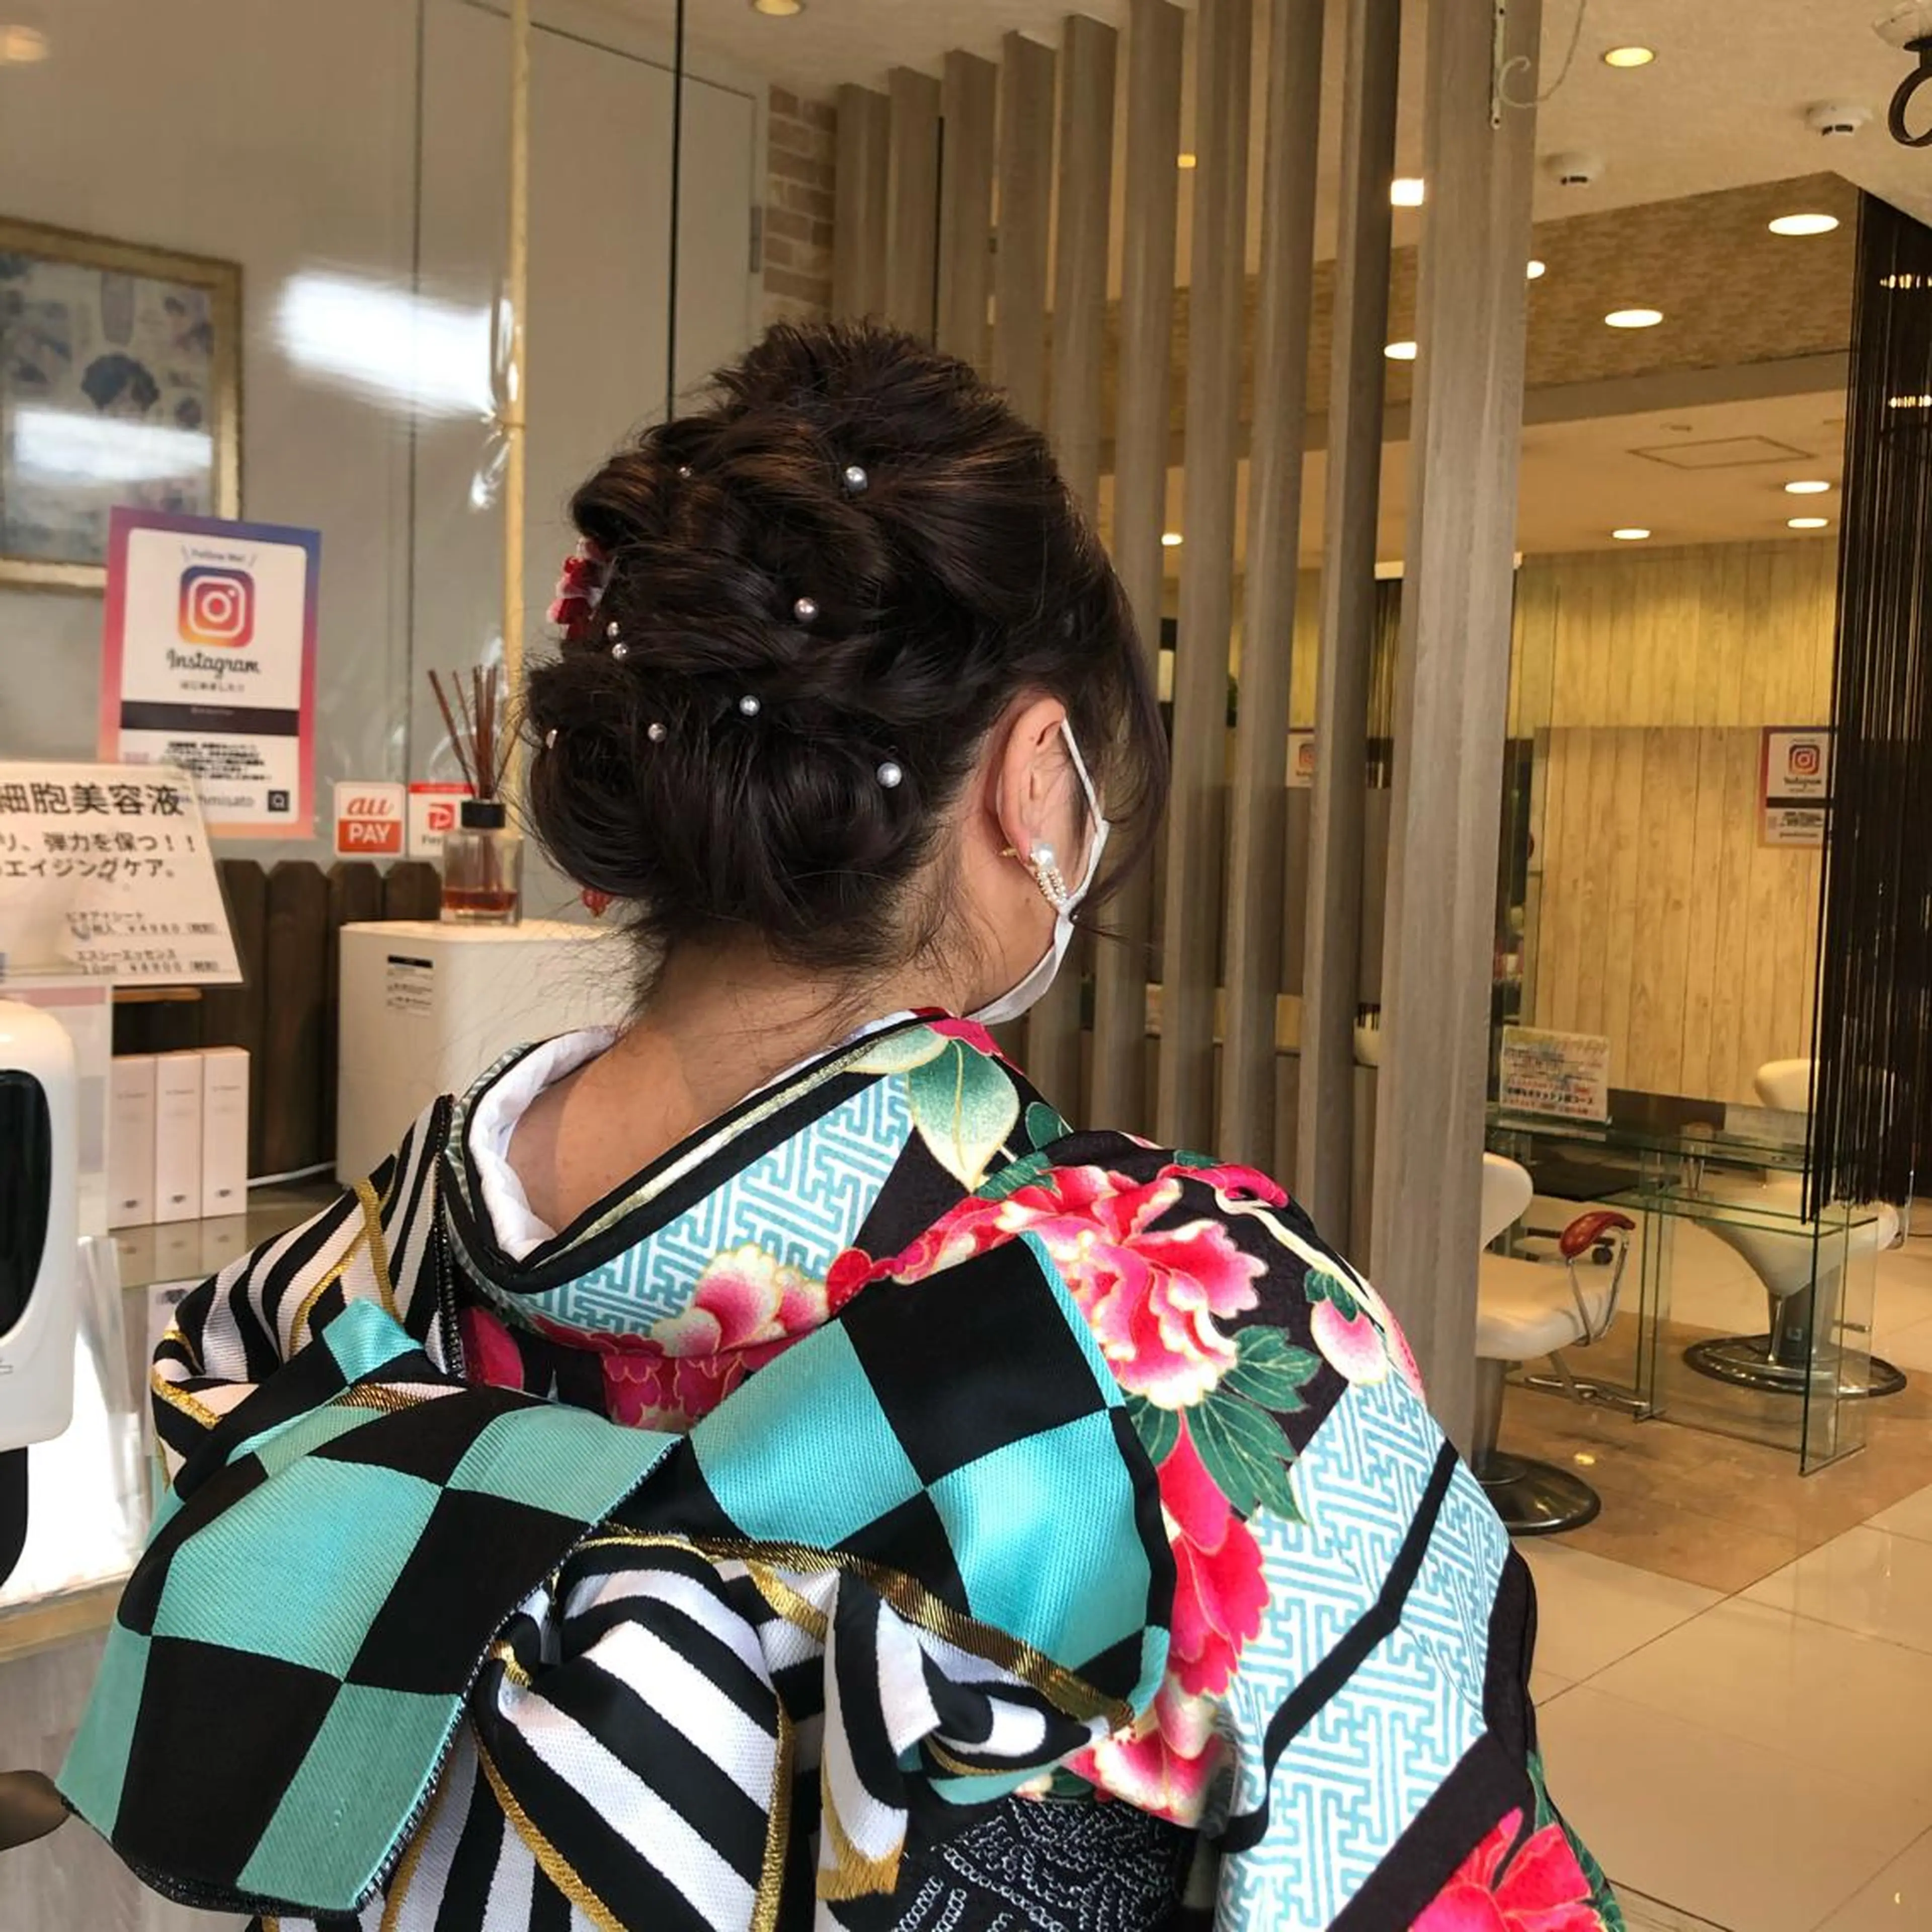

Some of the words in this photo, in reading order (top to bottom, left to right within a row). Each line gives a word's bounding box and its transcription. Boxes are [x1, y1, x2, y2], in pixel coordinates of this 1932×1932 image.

[167, 648, 261, 680] Instagram
[0, 783, 185, 816] 細胞美容液
[347, 797, 392, 816] au
[349, 822, 391, 844] PAY
[422, 835, 443, 846] Pay
[0, 857, 175, 882] エイジングケア。
